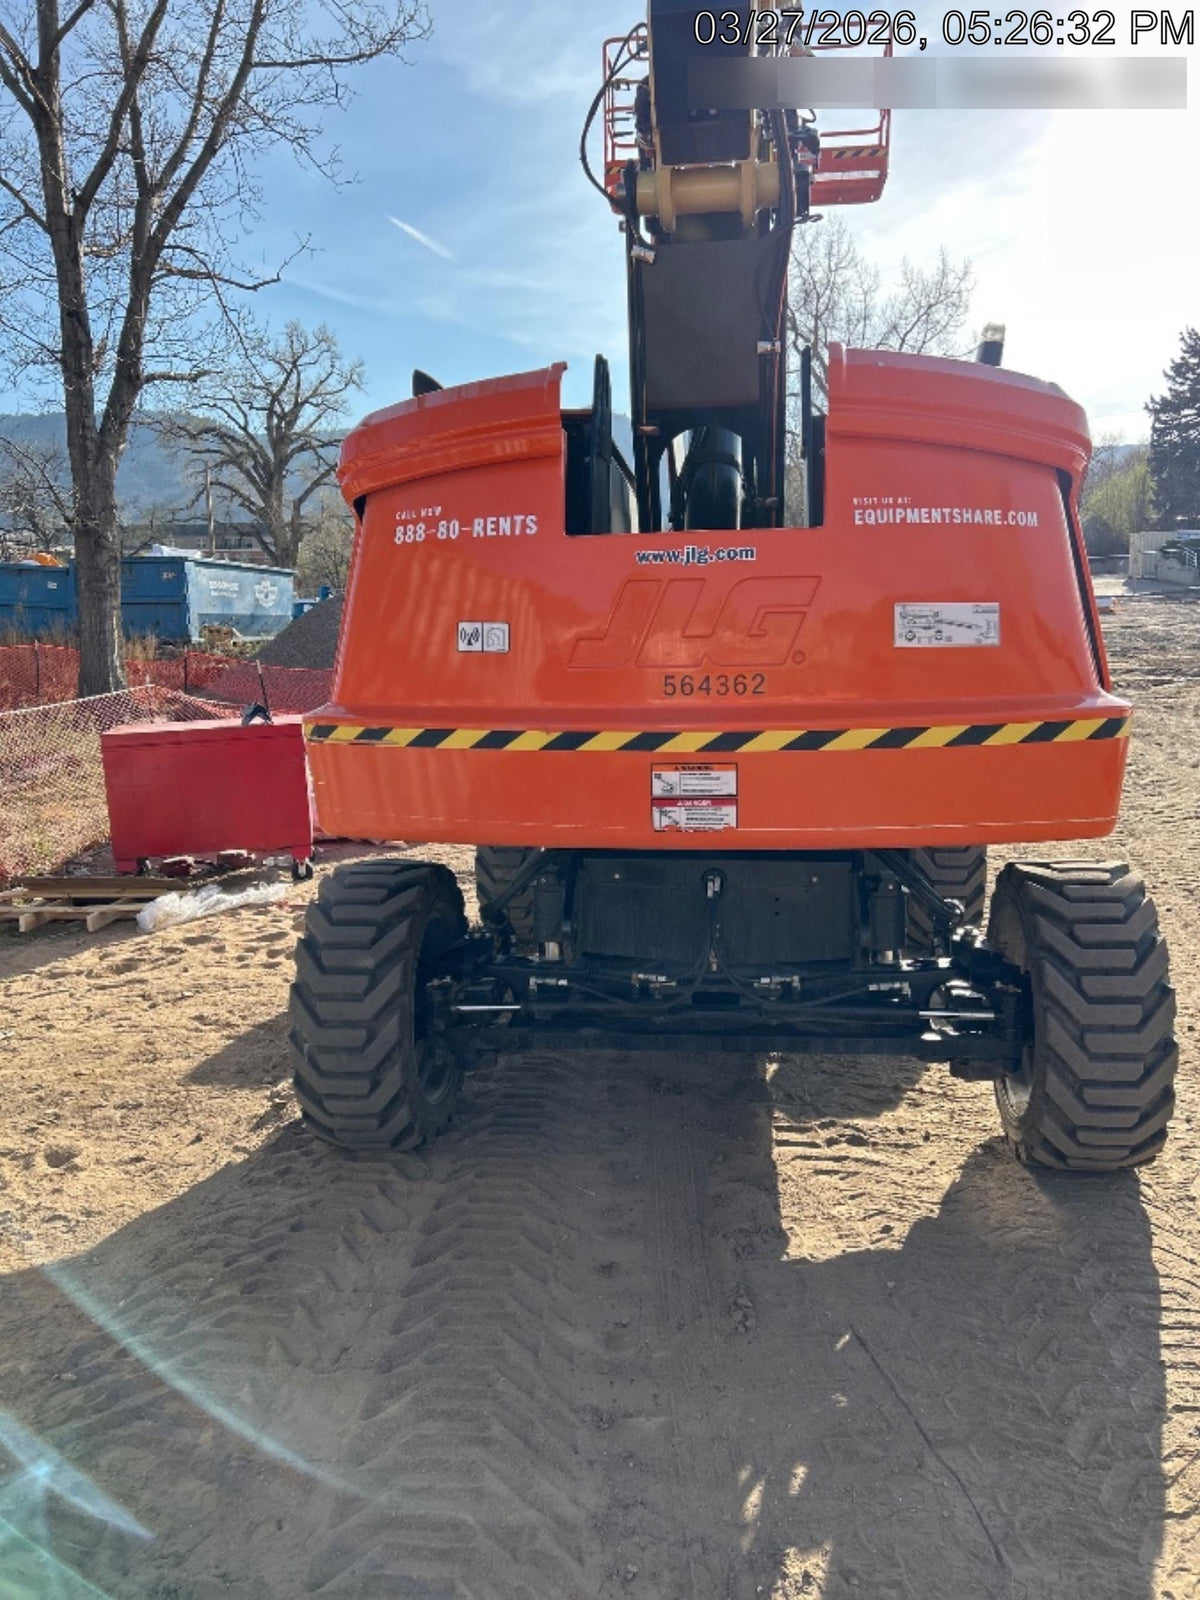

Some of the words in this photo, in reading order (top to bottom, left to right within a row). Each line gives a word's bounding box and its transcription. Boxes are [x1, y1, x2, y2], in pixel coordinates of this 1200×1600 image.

[854, 508, 1038, 527] EQUIPMENTSHARE.COM
[394, 515, 538, 545] 888-80-RENTS
[635, 546, 756, 565] www.jlg.com
[663, 673, 766, 696] 564362
